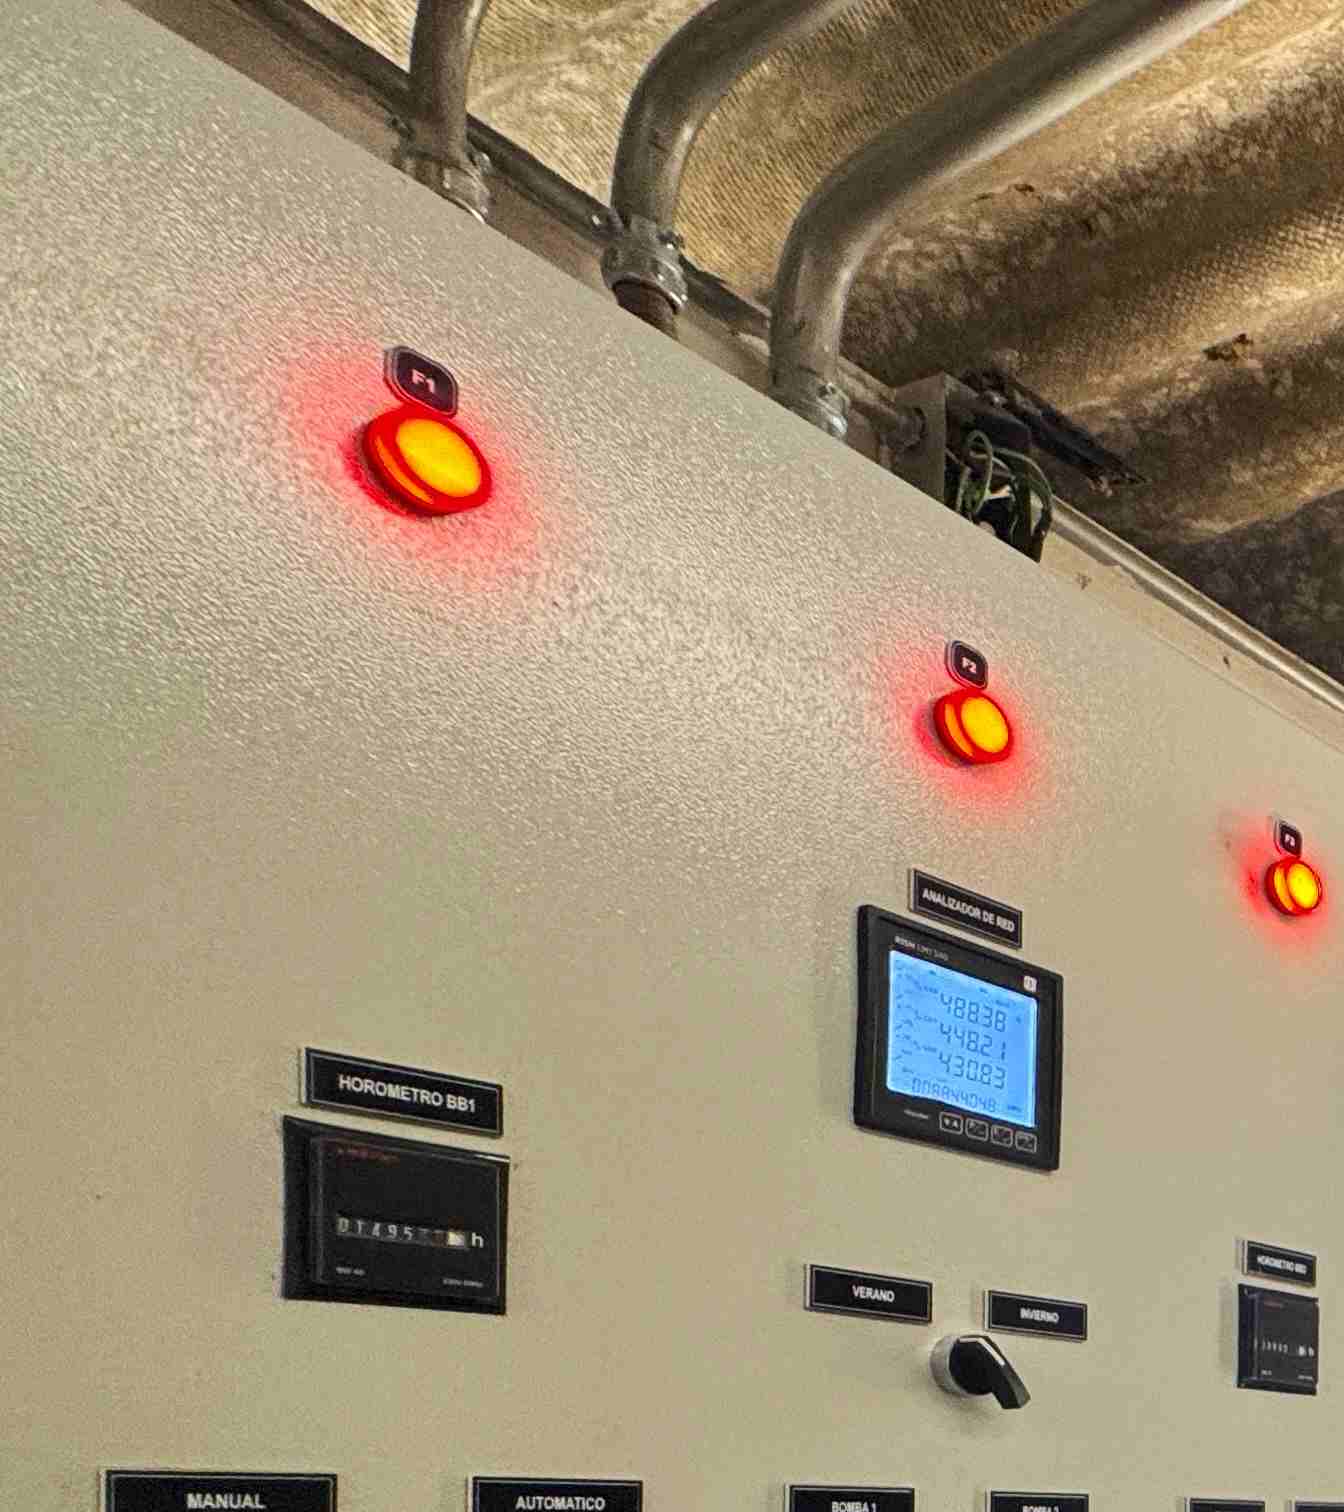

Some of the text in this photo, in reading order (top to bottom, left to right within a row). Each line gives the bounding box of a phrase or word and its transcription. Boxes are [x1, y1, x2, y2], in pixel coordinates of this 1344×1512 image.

[411, 368, 436, 394] F1
[961, 656, 977, 675] F2
[921, 887, 1015, 933] ANALIZADOR DE RED
[339, 1074, 476, 1113] HOROMETRO BB1
[471, 1232, 485, 1248] h
[852, 1285, 895, 1303] VERANO
[1020, 1307, 1060, 1324] INVIERNO
[187, 1492, 266, 1510] MANUAL
[515, 1495, 606, 1511] AUTOMATICO
